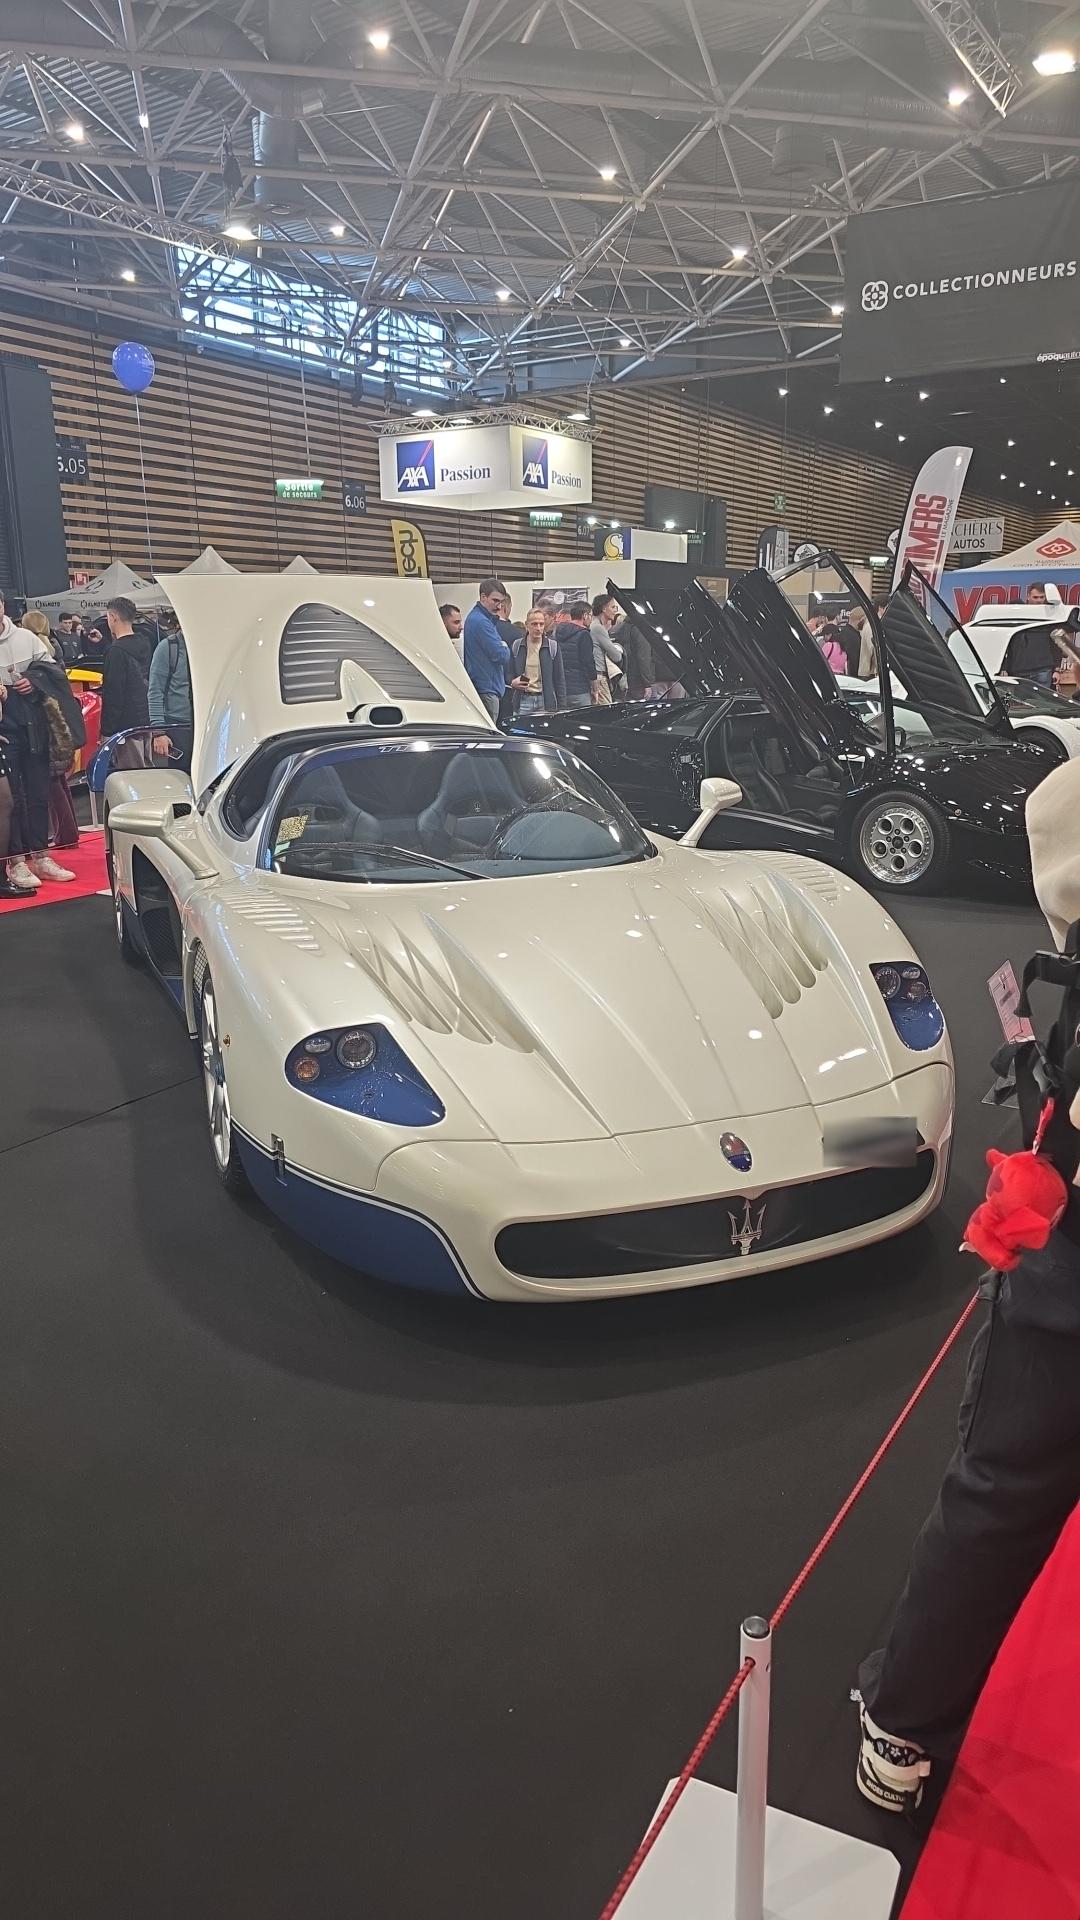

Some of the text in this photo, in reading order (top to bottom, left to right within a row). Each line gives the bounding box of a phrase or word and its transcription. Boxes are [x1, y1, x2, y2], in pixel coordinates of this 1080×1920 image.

[892, 260, 1077, 299] COLLECTIONNEURS
[397, 465, 430, 488] AXA
[440, 465, 491, 482] Passion
[522, 462, 545, 485] AXA
[551, 470, 582, 489] Passion
[285, 482, 314, 491] Sortie
[345, 494, 365, 509] 6.06
[953, 538, 986, 549] AUTOS
